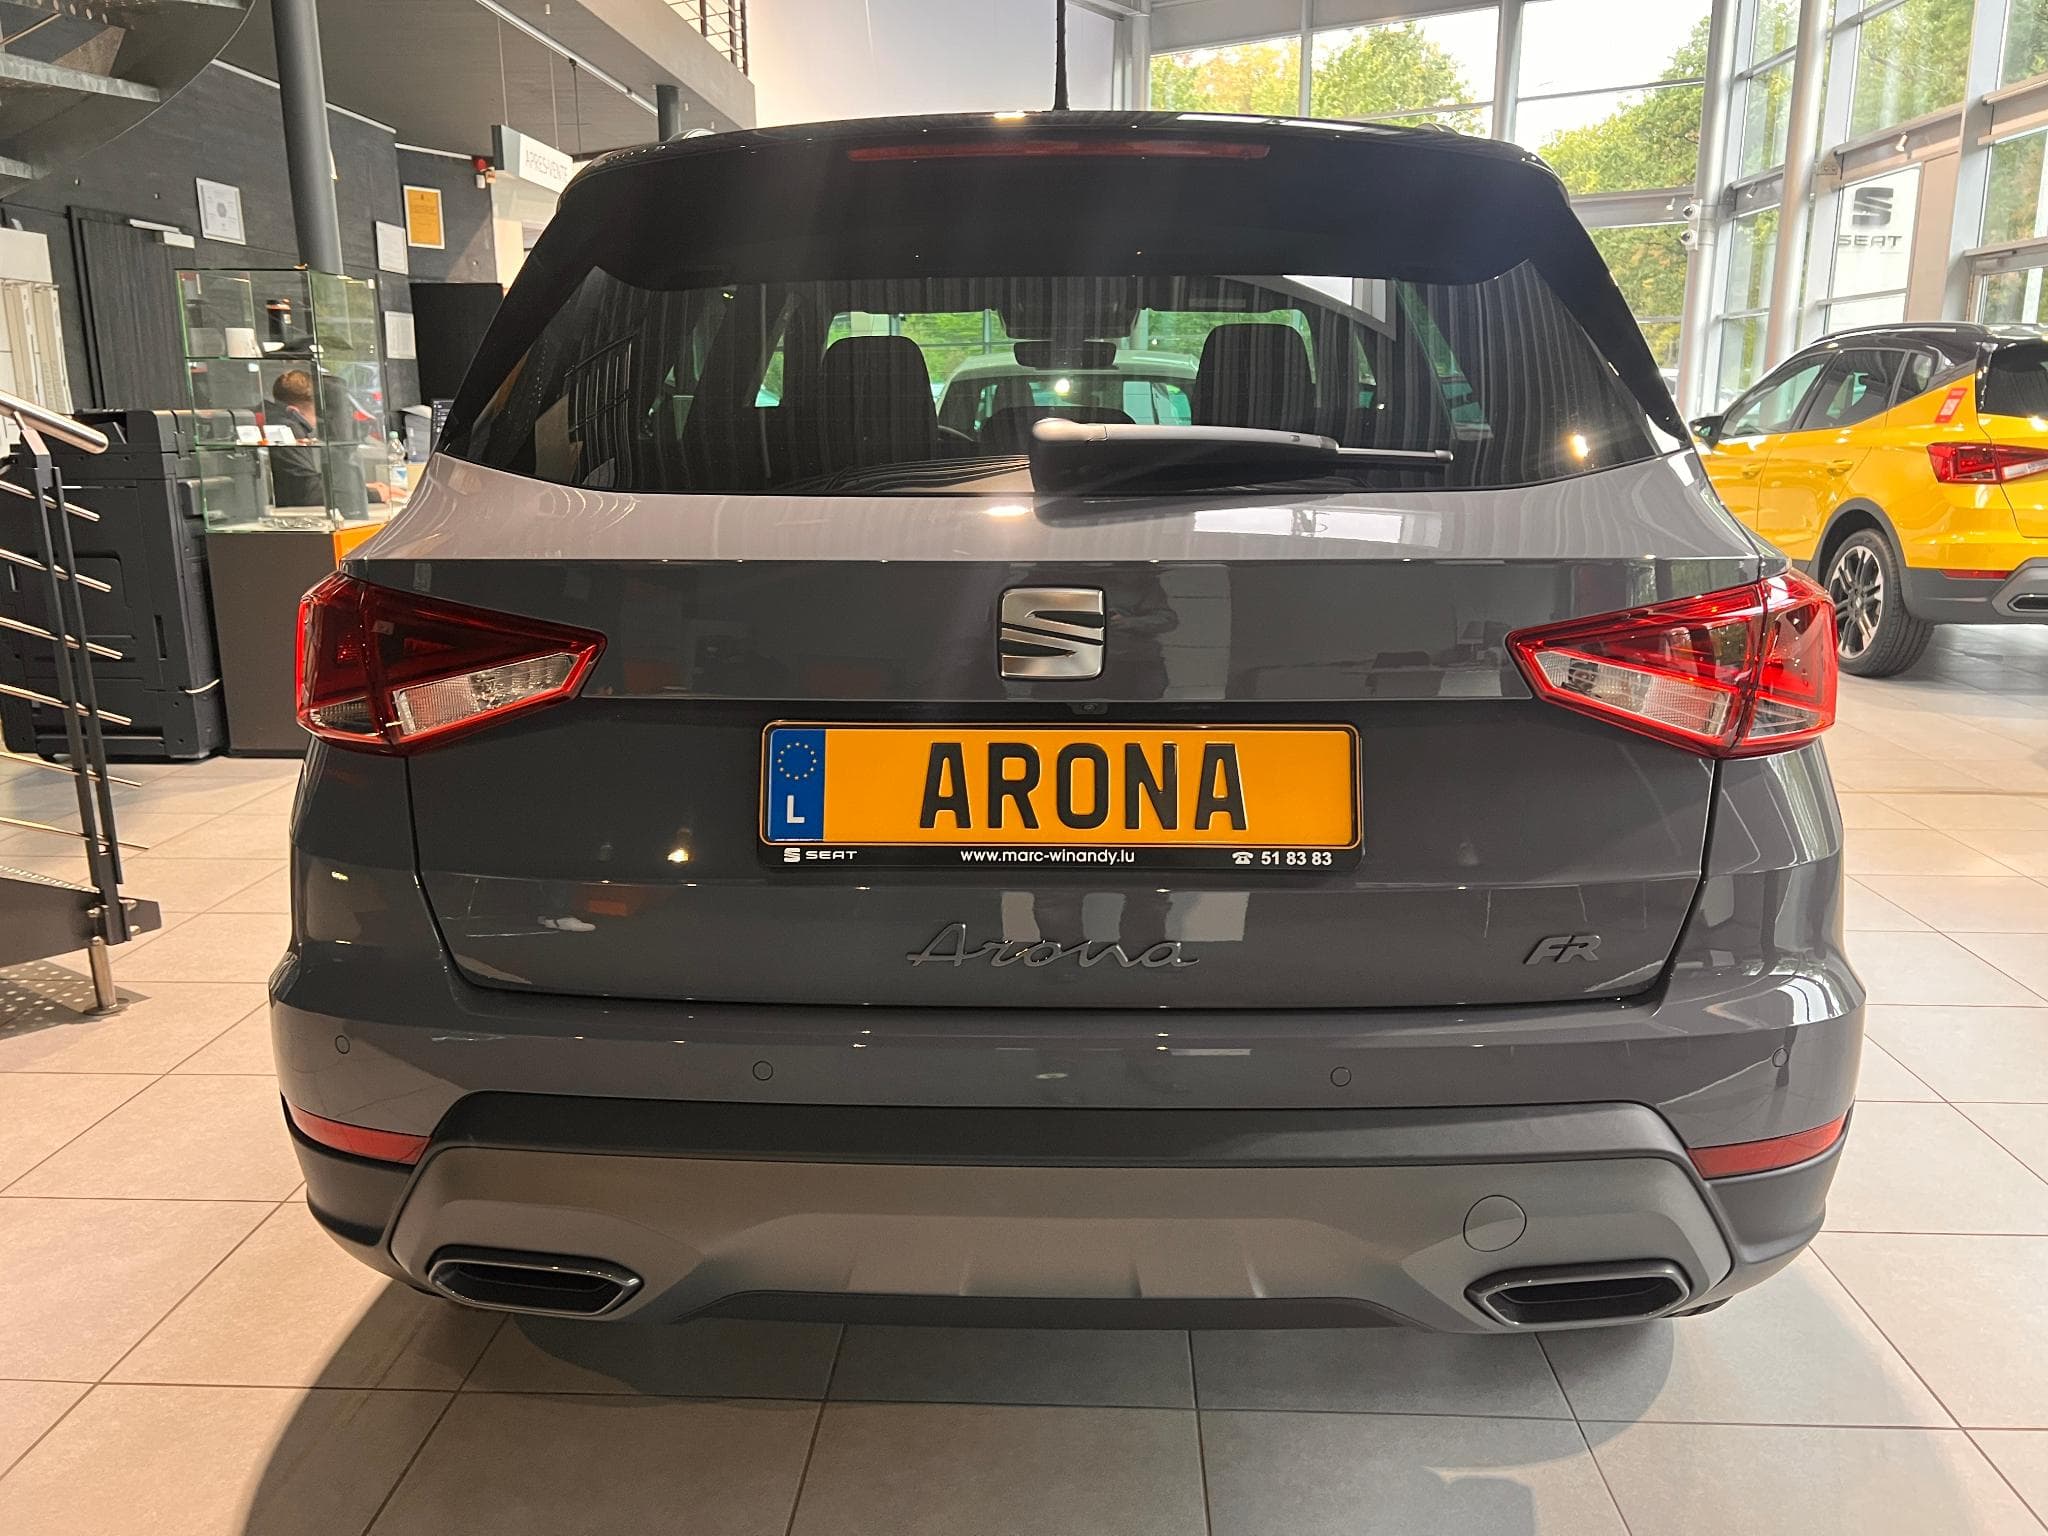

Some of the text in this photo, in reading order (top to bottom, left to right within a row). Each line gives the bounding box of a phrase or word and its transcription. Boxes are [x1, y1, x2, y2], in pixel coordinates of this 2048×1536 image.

[1838, 235, 1903, 248] SEAT
[919, 742, 1248, 830] ARONA
[786, 794, 805, 824] L
[805, 850, 858, 860] SEAT
[960, 848, 1135, 865] www.marc-winandy.lu
[1261, 851, 1333, 866] 51 83 83
[906, 921, 1200, 968] Arona
[1524, 935, 1602, 965] FR
